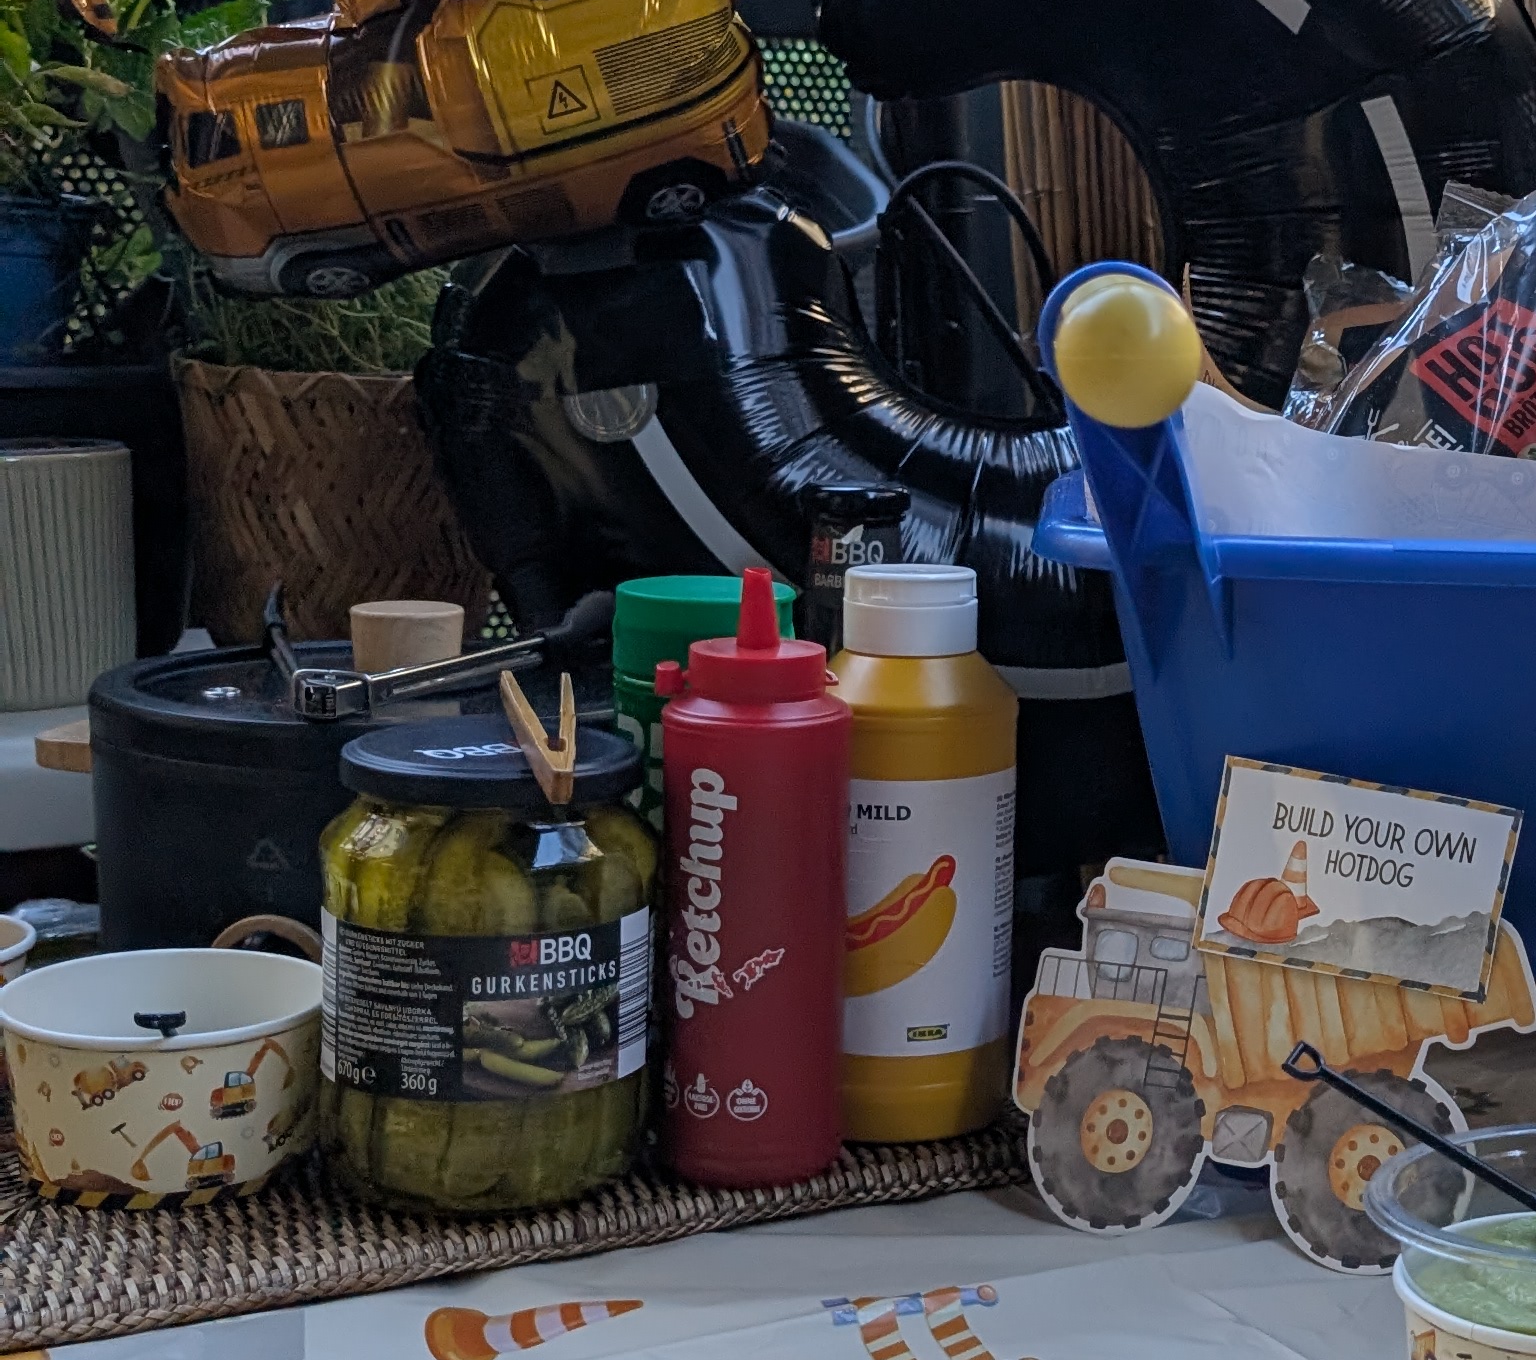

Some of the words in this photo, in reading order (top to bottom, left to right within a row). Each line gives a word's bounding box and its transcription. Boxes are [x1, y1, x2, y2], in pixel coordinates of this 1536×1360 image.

[831, 540, 884, 565] BBQ
[857, 804, 912, 821] MILD
[1272, 802, 1335, 838] BUILD
[1344, 813, 1406, 854] YOUR
[1414, 828, 1477, 864] OWN
[1324, 849, 1415, 888] HOTDOG
[669, 767, 738, 1019] Ketchup
[540, 933, 592, 965] BBQ
[471, 960, 616, 995] GURKENSTICKS
[337, 1059, 353, 1079] 670
[400, 1073, 426, 1091] 360
[428, 1078, 438, 1096] g
